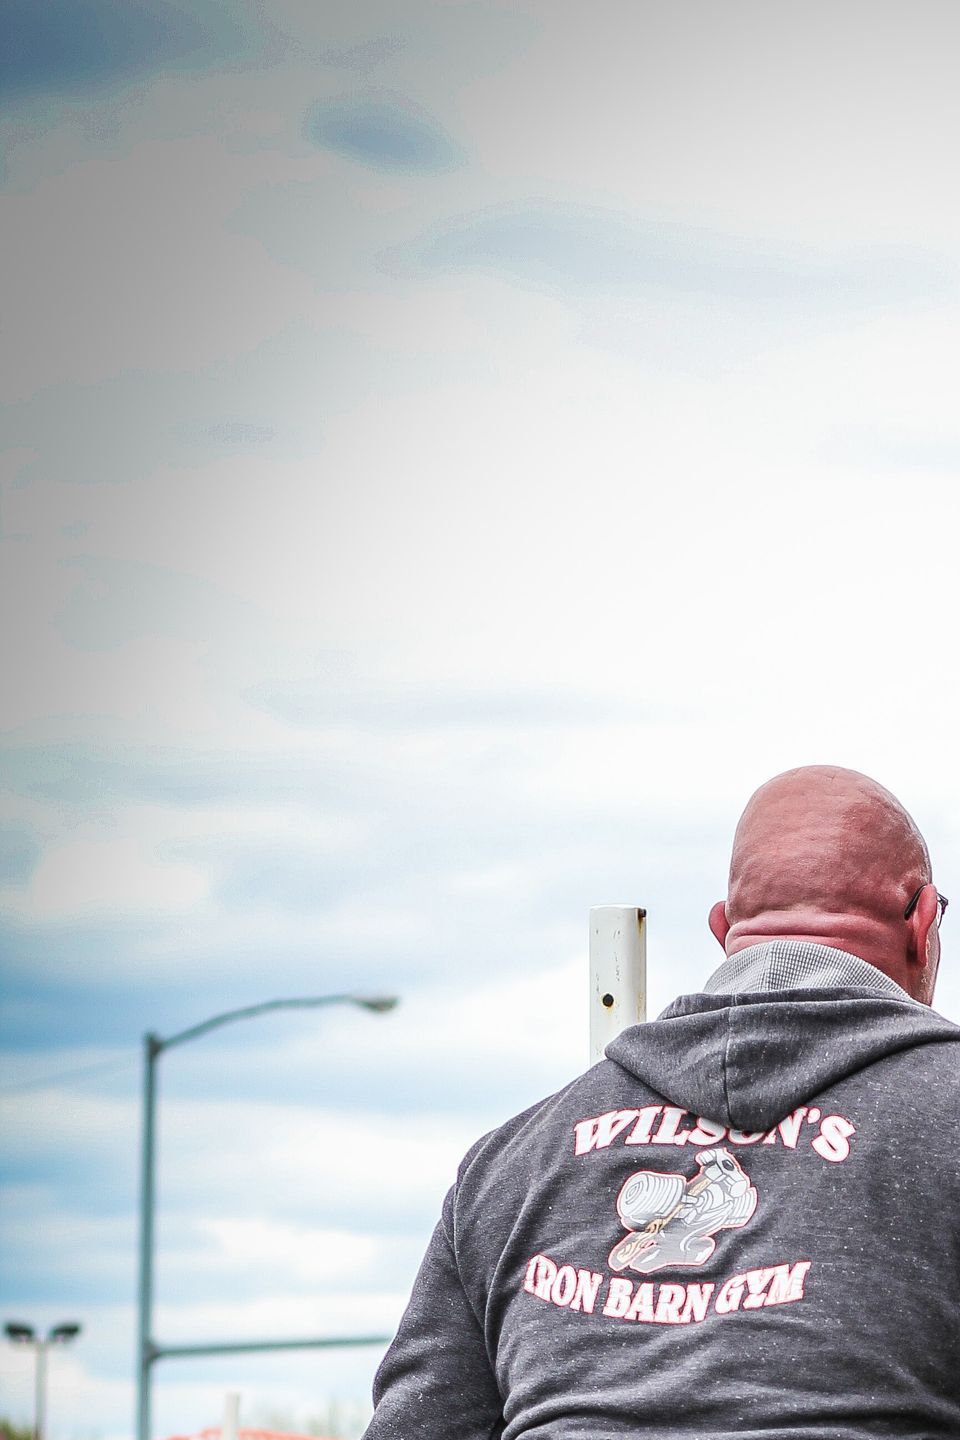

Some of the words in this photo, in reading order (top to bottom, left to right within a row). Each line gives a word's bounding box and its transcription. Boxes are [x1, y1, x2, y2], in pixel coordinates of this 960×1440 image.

[524, 1254, 604, 1315] IRON
[602, 1277, 717, 1325] BARN
[714, 1261, 812, 1315] GYM
